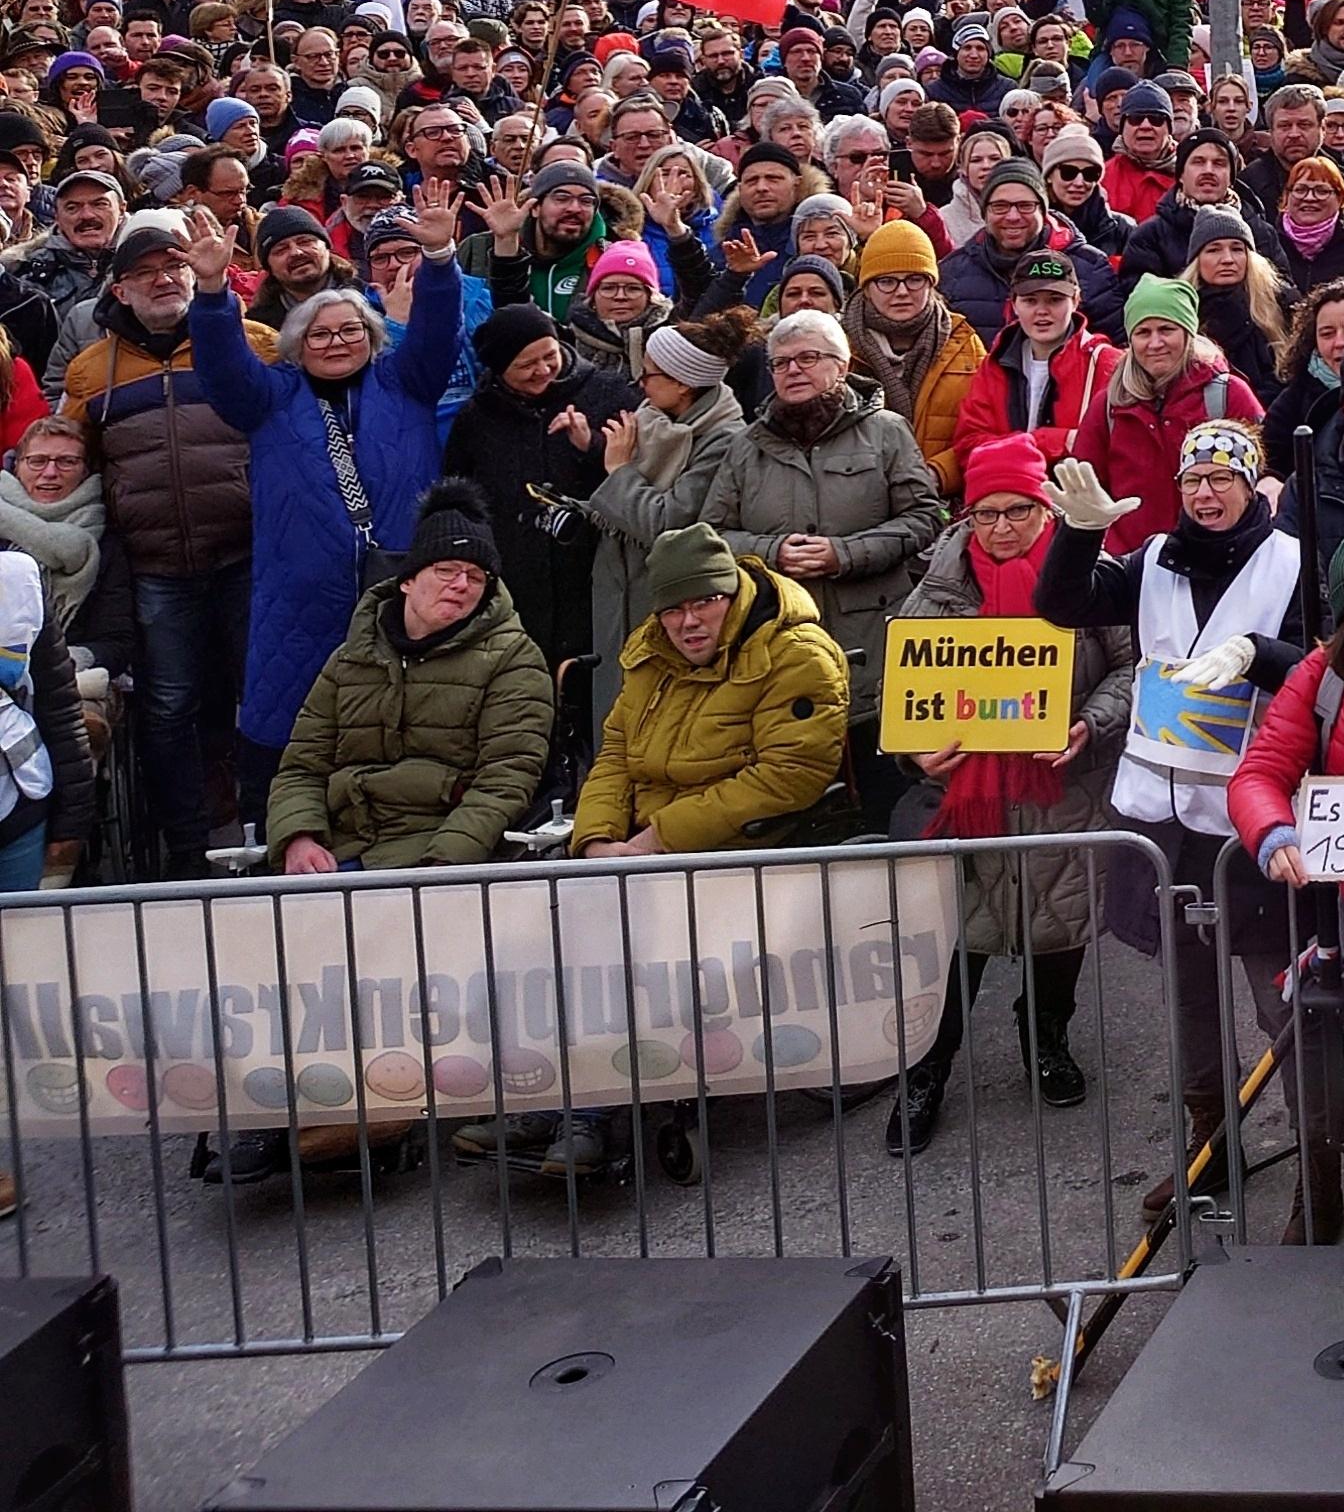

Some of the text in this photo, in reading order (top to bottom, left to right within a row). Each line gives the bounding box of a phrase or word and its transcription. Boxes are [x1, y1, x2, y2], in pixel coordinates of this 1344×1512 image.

[1029, 262, 1063, 275] ASS
[900, 636, 1058, 667] München
[905, 690, 1048, 721] ist bunt!
[1309, 789, 1341, 821] Es
